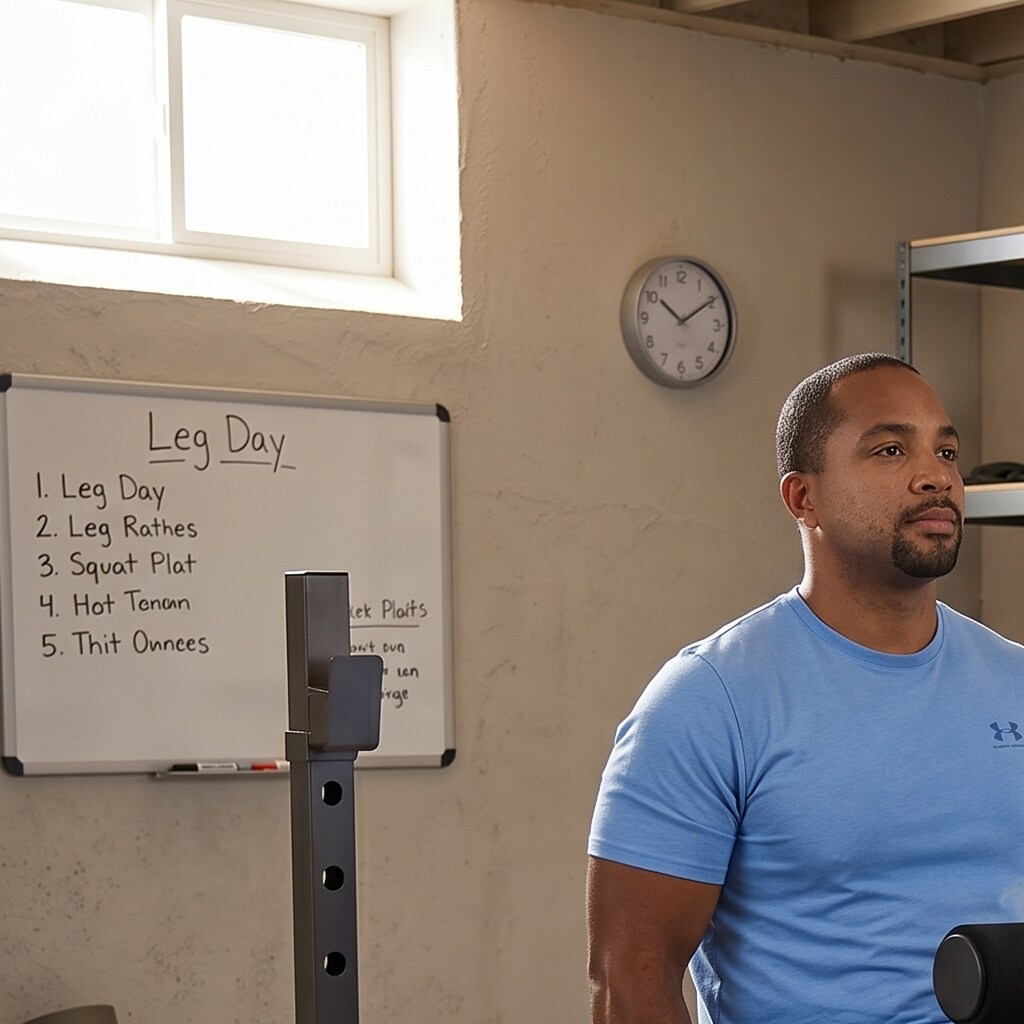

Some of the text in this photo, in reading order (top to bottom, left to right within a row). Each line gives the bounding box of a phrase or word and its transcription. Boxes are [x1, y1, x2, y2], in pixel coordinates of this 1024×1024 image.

[659, 275, 668, 288] 11
[676, 270, 687, 284] 12
[646, 290, 659, 304] 10
[641, 312, 649, 325] 9
[713, 319, 721, 332] 3
[646, 335, 654, 349] 8
[660, 353, 668, 368] 7
[695, 356, 704, 369] 5
[677, 361, 686, 375] 6
[149, 412, 287, 473] Leg Day
[37, 472, 165, 511] 1. Leg Day
[36, 514, 198, 548] 2. Leg Rathes
[37, 551, 197, 585] 3. Squat Plat
[39, 594, 59, 618] 4.
[73, 593, 115, 616] Hot
[42, 633, 64, 657] 5.
[71, 631, 121, 655] Thit
